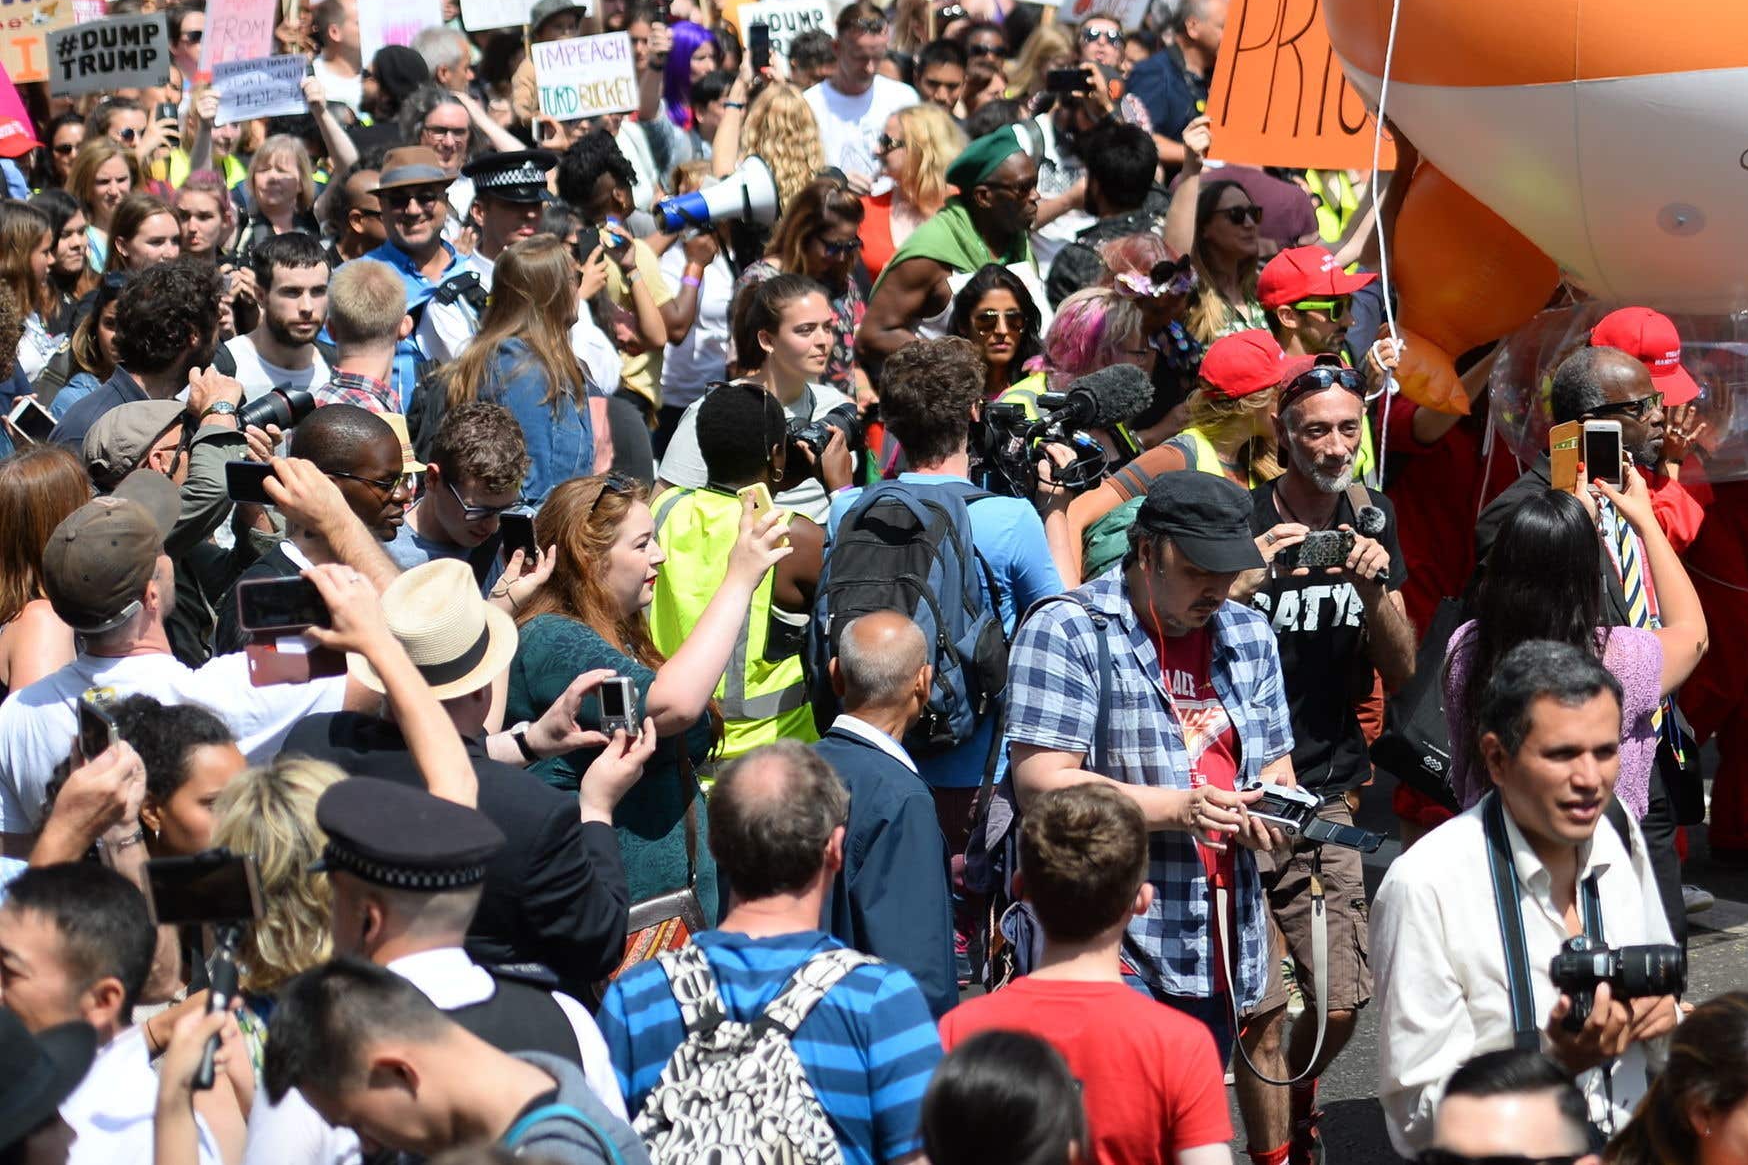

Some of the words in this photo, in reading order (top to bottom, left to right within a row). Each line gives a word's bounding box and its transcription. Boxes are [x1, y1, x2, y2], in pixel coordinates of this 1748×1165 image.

[56, 23, 160, 59] #DUMP
[540, 39, 627, 71] IMPEACH
[59, 48, 158, 81] TRUMP
